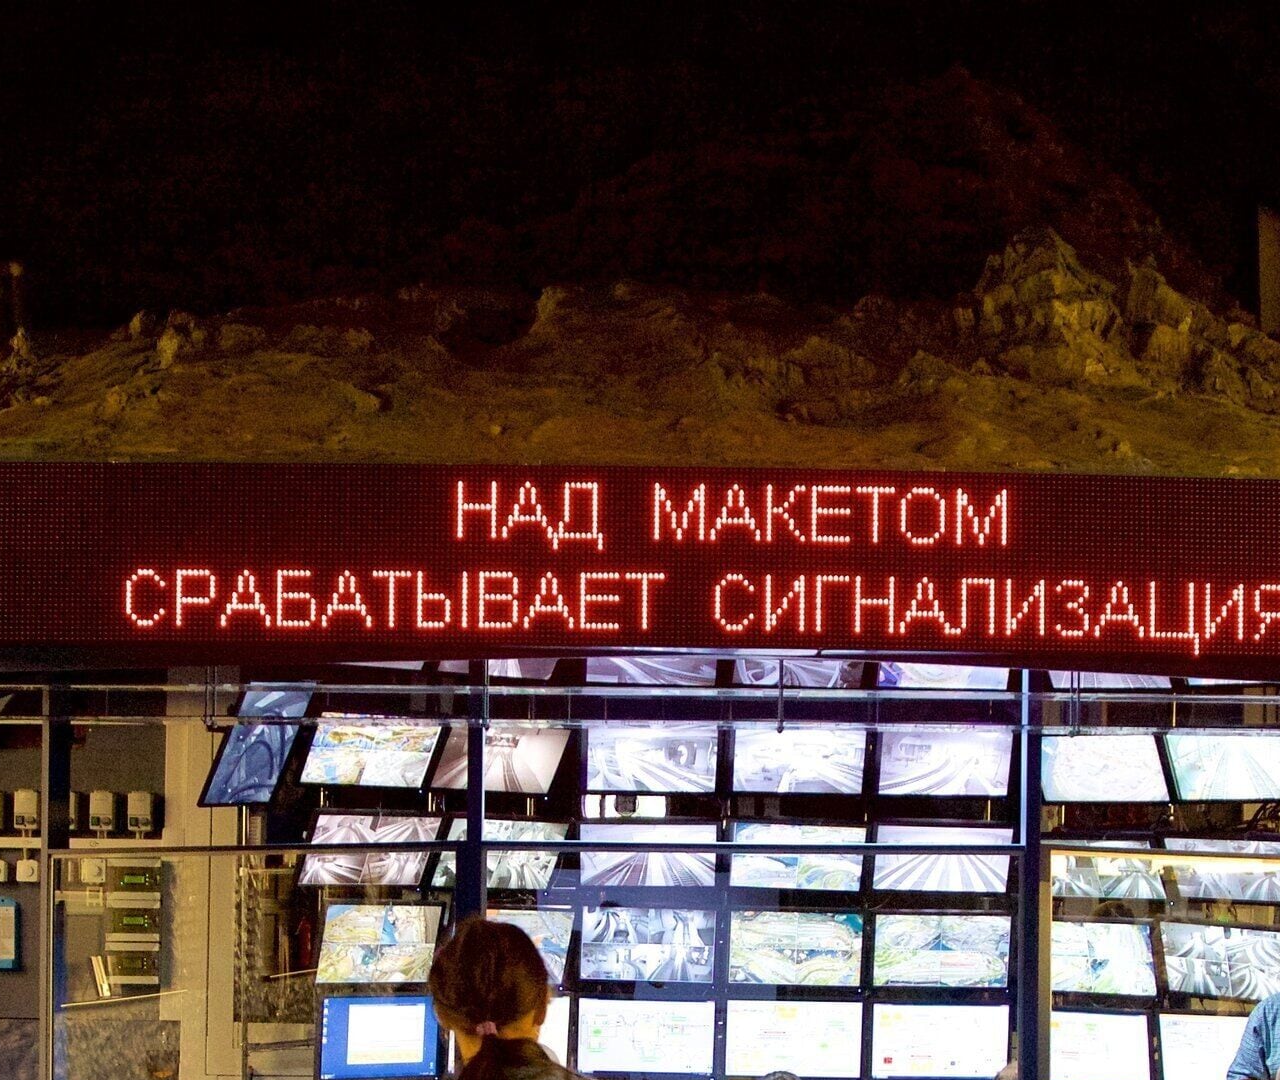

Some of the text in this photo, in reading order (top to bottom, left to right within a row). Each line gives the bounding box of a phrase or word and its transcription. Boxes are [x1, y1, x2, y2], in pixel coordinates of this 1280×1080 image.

[456, 480, 1008, 550] НАД МАКЕТОМ
[124, 568, 666, 630] СРАБАТЫВАЕТ
